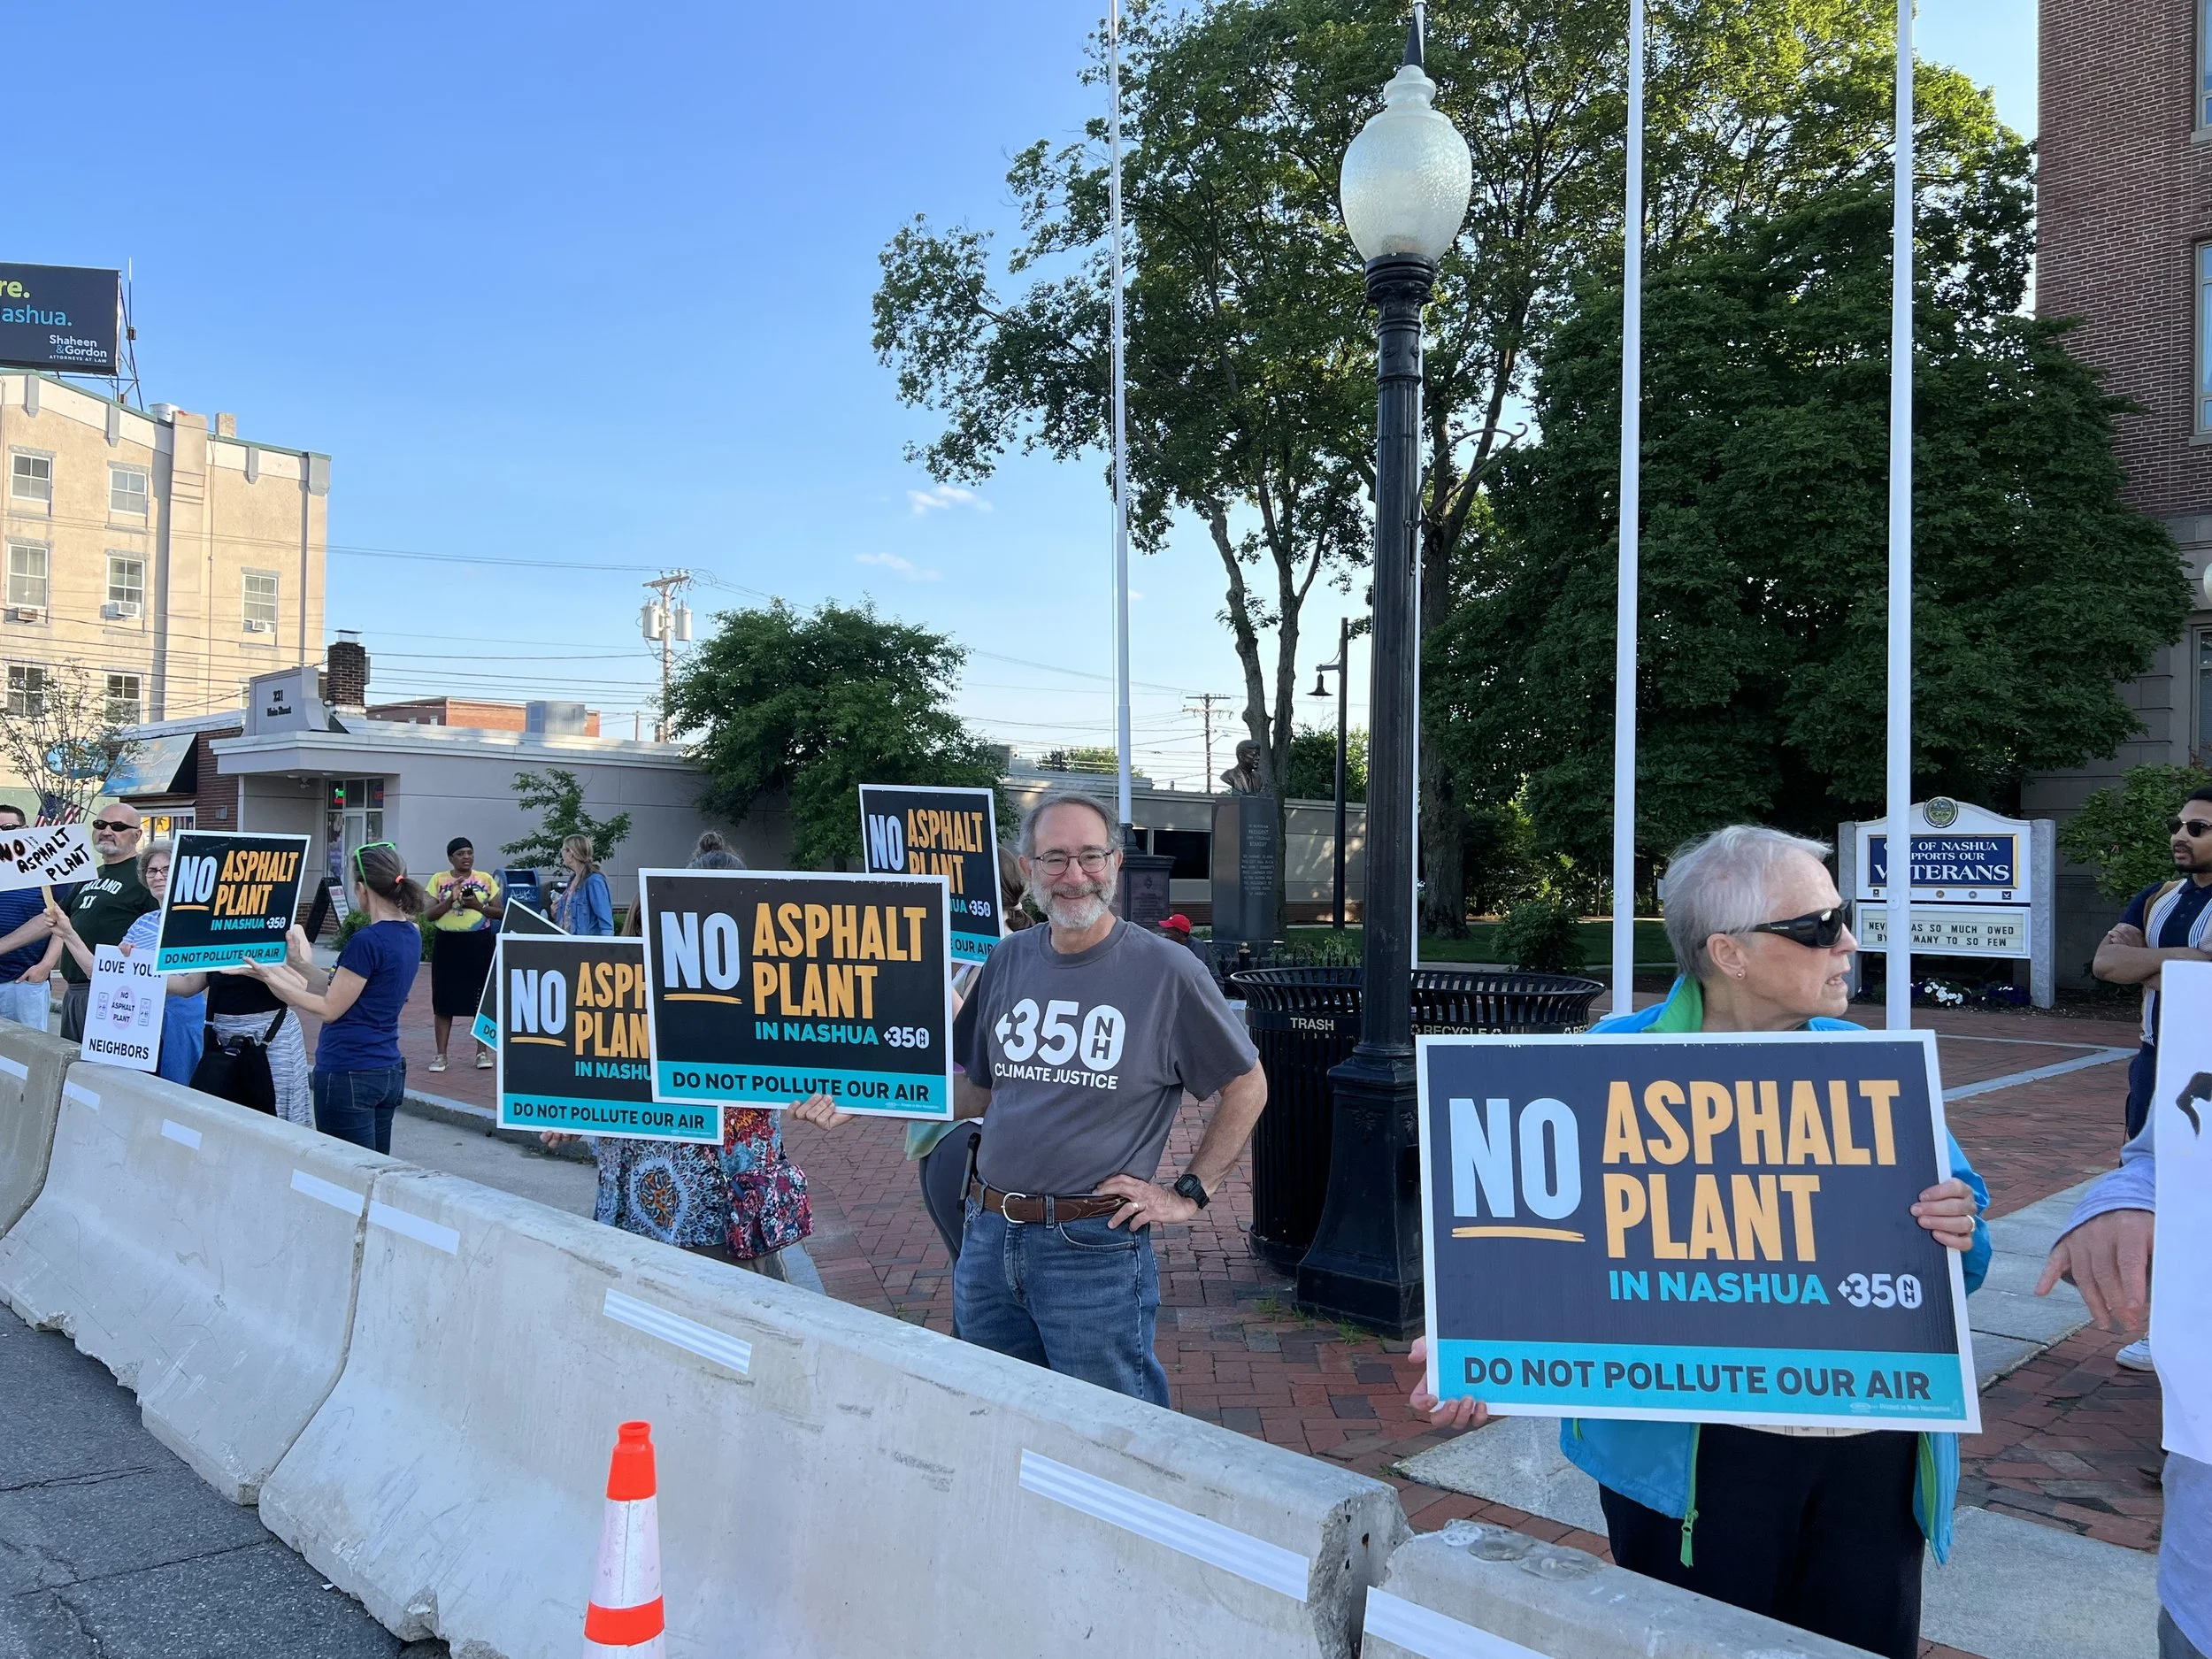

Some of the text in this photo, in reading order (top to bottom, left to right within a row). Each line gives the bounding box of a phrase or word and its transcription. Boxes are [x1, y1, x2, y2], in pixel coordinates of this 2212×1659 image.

[0, 304, 73, 326] ashua.
[49, 334, 97, 348] Shaheen
[0, 839, 26, 863] NO
[16, 826, 71, 874] ASPHALT
[868, 808, 983, 872] NO ASPHALT
[1918, 842, 1937, 851] OF
[1941, 842, 1999, 851] NASHUA
[45, 842, 90, 881] PLANT
[908, 850, 964, 895] PLANT
[1874, 864, 2010, 881] VTERANS
[173, 856, 218, 902] NO
[219, 850, 299, 882] ASPHALT
[213, 885, 273, 917] PLANT
[211, 917, 287, 931] IN NASHUA 350
[1869, 922, 1887, 931] NEV
[1930, 924, 1941, 933] SO
[1987, 926, 2014, 934] OWED
[660, 902, 927, 991] NO ASPHALT
[956, 939, 975, 954] OUR
[1913, 935, 1939, 944] MANY
[1947, 936, 1958, 945] TO
[1987, 938, 2007, 947] FEW
[98, 959, 161, 979] LOVE YOU
[165, 948, 280, 964] DO NOT POLLUTE OUR AIR
[510, 962, 648, 1035] NO ASPH
[752, 962, 878, 1019] PLANT
[111, 1002, 134, 1012] ASPHALT
[113, 1014, 131, 1023] PLANT
[483, 1025, 496, 1040] DO
[575, 1011, 650, 1059] PLAN
[755, 1021, 930, 1049] IN NASHUA 350
[1003, 998, 1126, 1072] 350
[1290, 1017, 1334, 1032] TRASH
[88, 1038, 150, 1060] NEIGHBORS
[575, 1061, 652, 1081] IN NASHU
[995, 1062, 1119, 1090] CLIMATE JUSTICE
[672, 1072, 929, 1102] DO NOT POLLUTE OUR AIR
[513, 1102, 704, 1129] DO NOT POLLUTE OUR AIR
[1449, 1079, 1901, 1221] NO ASPHALT
[1604, 1173, 1820, 1262] PLANT
[1609, 1271, 1923, 1310] IN NASHUA 350
[1464, 1356, 1932, 1402] DO NOT POLLUTE OUR AIR
